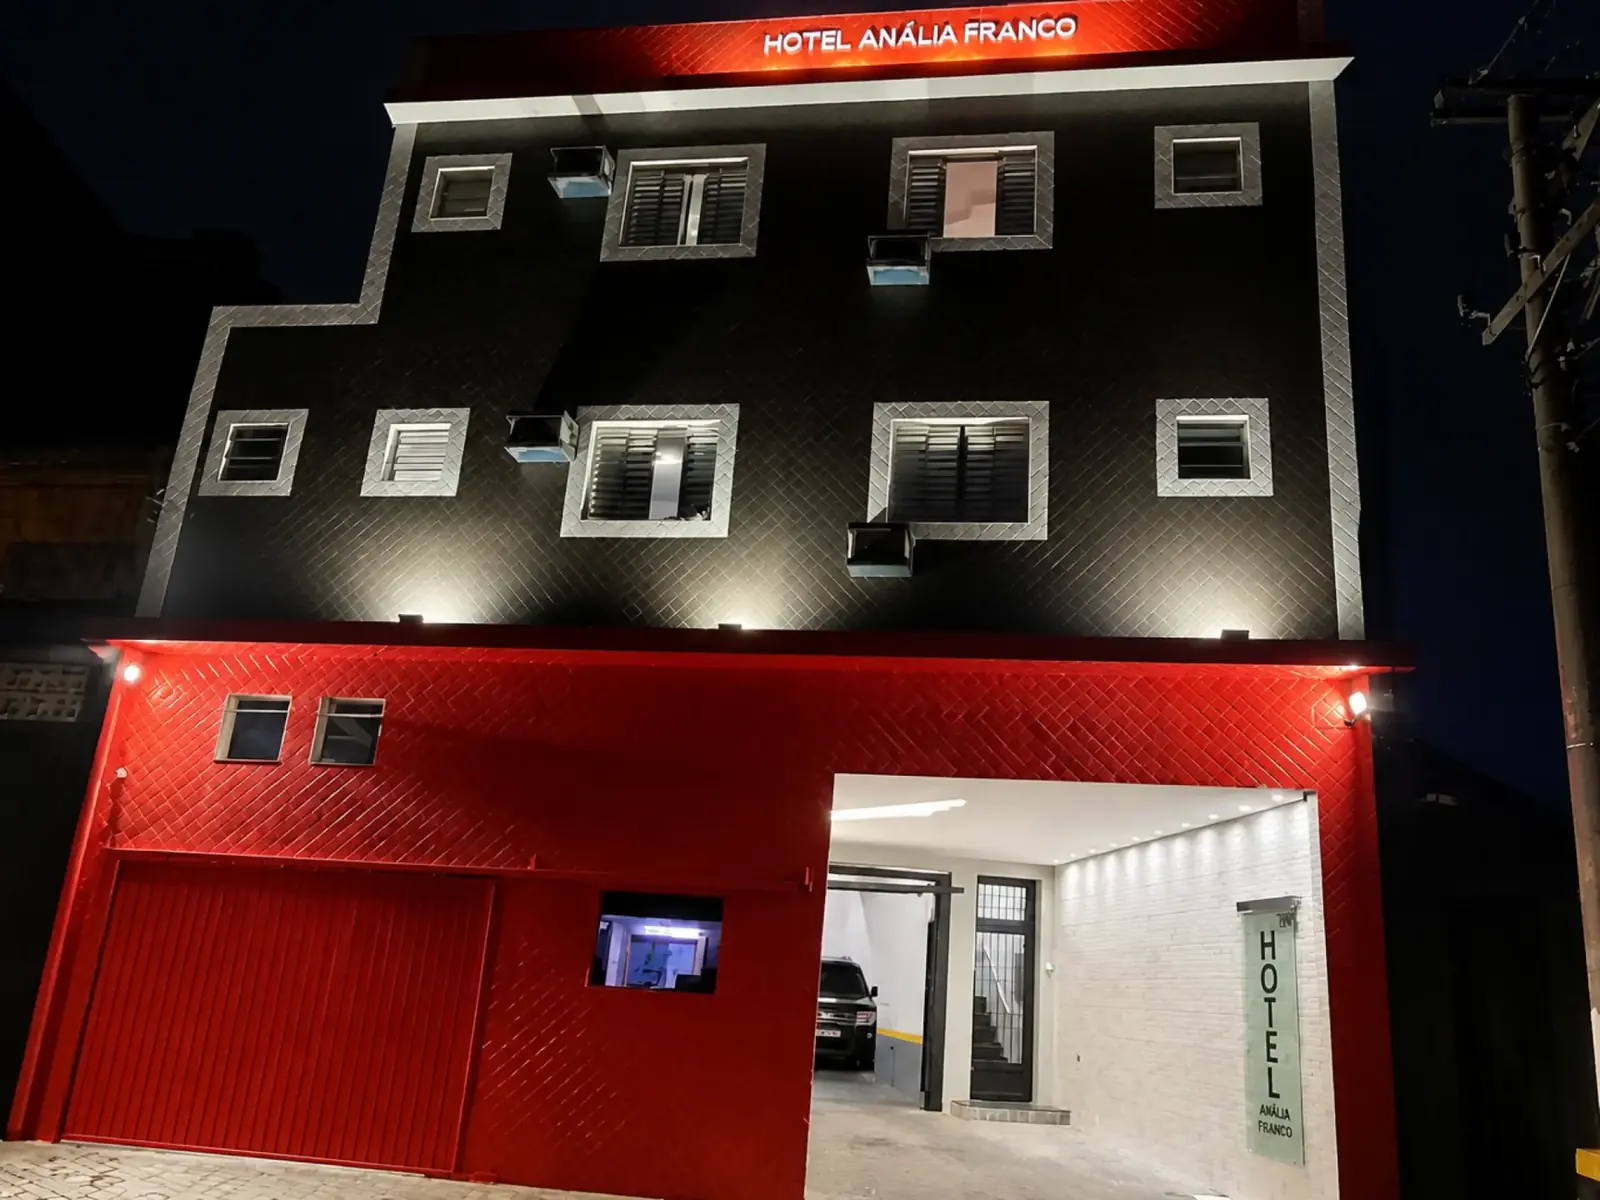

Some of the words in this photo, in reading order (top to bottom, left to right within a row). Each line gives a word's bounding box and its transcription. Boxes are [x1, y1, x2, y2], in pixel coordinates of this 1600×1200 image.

[764, 29, 851, 55] HOTEL
[858, 21, 957, 49] ANÁLIA
[964, 17, 1077, 43] FRANCO
[1260, 930, 1281, 1099] HOTEL
[1260, 1103, 1291, 1121] ANÁLIA
[1258, 1119, 1293, 1138] FRANCO
